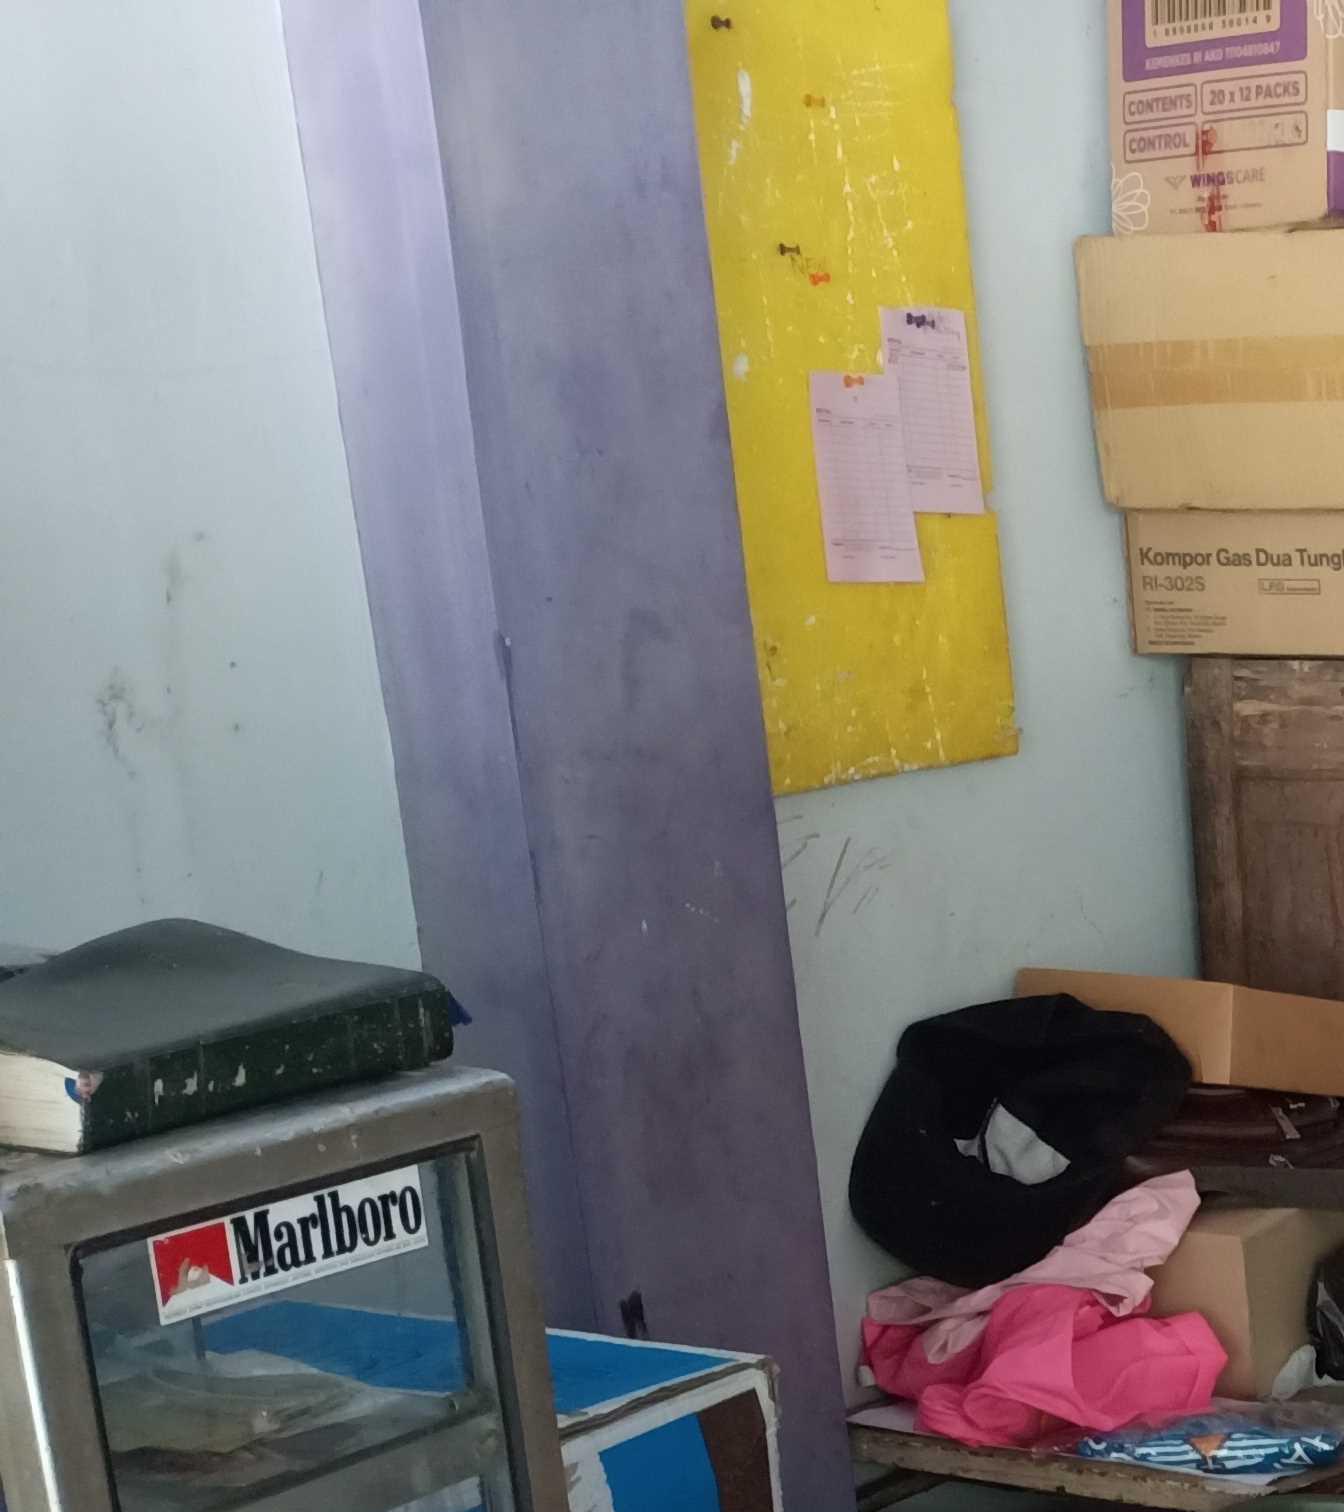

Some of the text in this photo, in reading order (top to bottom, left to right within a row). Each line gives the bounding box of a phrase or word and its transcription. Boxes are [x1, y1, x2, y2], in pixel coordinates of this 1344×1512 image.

[1128, 80, 1300, 117] CONTENTS 20 x 12 PACKS
[1128, 132, 1190, 154] CONTROL
[1139, 547, 1212, 569] Kompor
[1216, 548, 1252, 567] Gas
[1255, 548, 1293, 567] Dua
[1142, 576, 1206, 592] RI-302S
[230, 1185, 423, 1285] Marlboro
